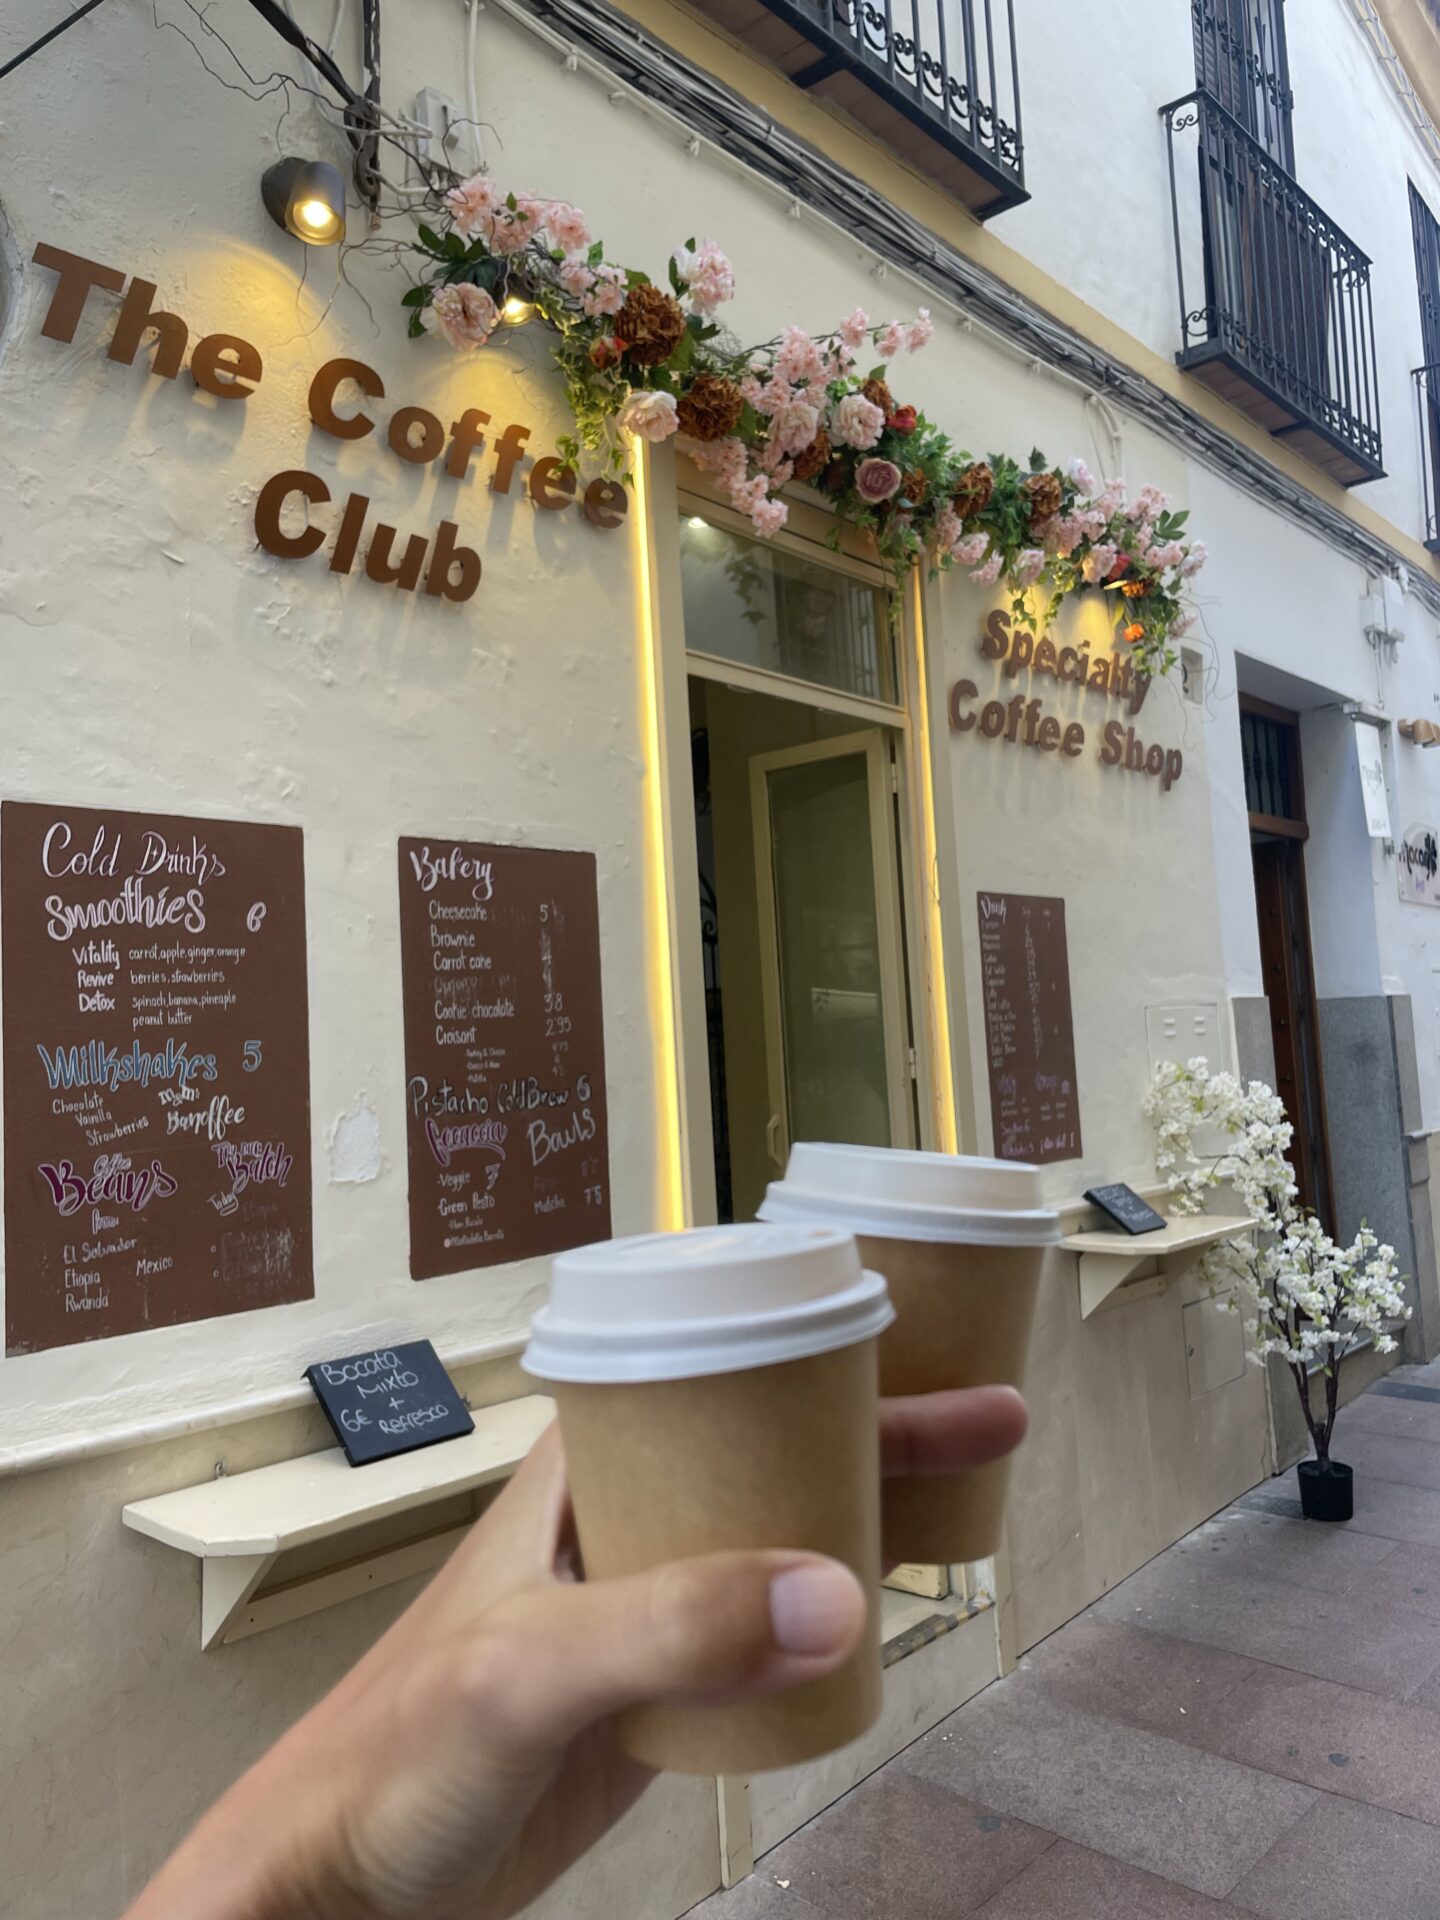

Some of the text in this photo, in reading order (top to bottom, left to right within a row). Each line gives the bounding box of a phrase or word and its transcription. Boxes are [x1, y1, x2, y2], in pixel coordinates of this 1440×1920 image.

[32, 241, 628, 529] The Coffee
[254, 469, 482, 603] Club
[981, 609, 1152, 716] Specialty
[951, 678, 1183, 791] Coffee Shop
[42, 821, 226, 886] Cold Drinks
[409, 846, 494, 902] Bakery
[45, 875, 267, 942] Smoothies 6
[428, 899, 488, 921] Cheesecake
[430, 923, 476, 948] Brownie
[72, 939, 121, 970] Vitality
[433, 950, 466, 971] Carrot
[77, 970, 115, 988] Revive
[78, 990, 116, 1013] Detox
[434, 999, 468, 1020] Cookie
[37, 1037, 263, 1092] Milkshakes 5
[408, 1075, 489, 1119] Pistacho
[576, 1075, 592, 1102] 6
[85, 1115, 150, 1147] Strawberries
[38, 1159, 178, 1217] Beans
[64, 1268, 101, 1294] Etiopia
[136, 1255, 174, 1277] Mexico
[65, 1288, 109, 1313] Rwanda
[320, 1351, 402, 1385] Bocata
[340, 1408, 373, 1432] 6€
